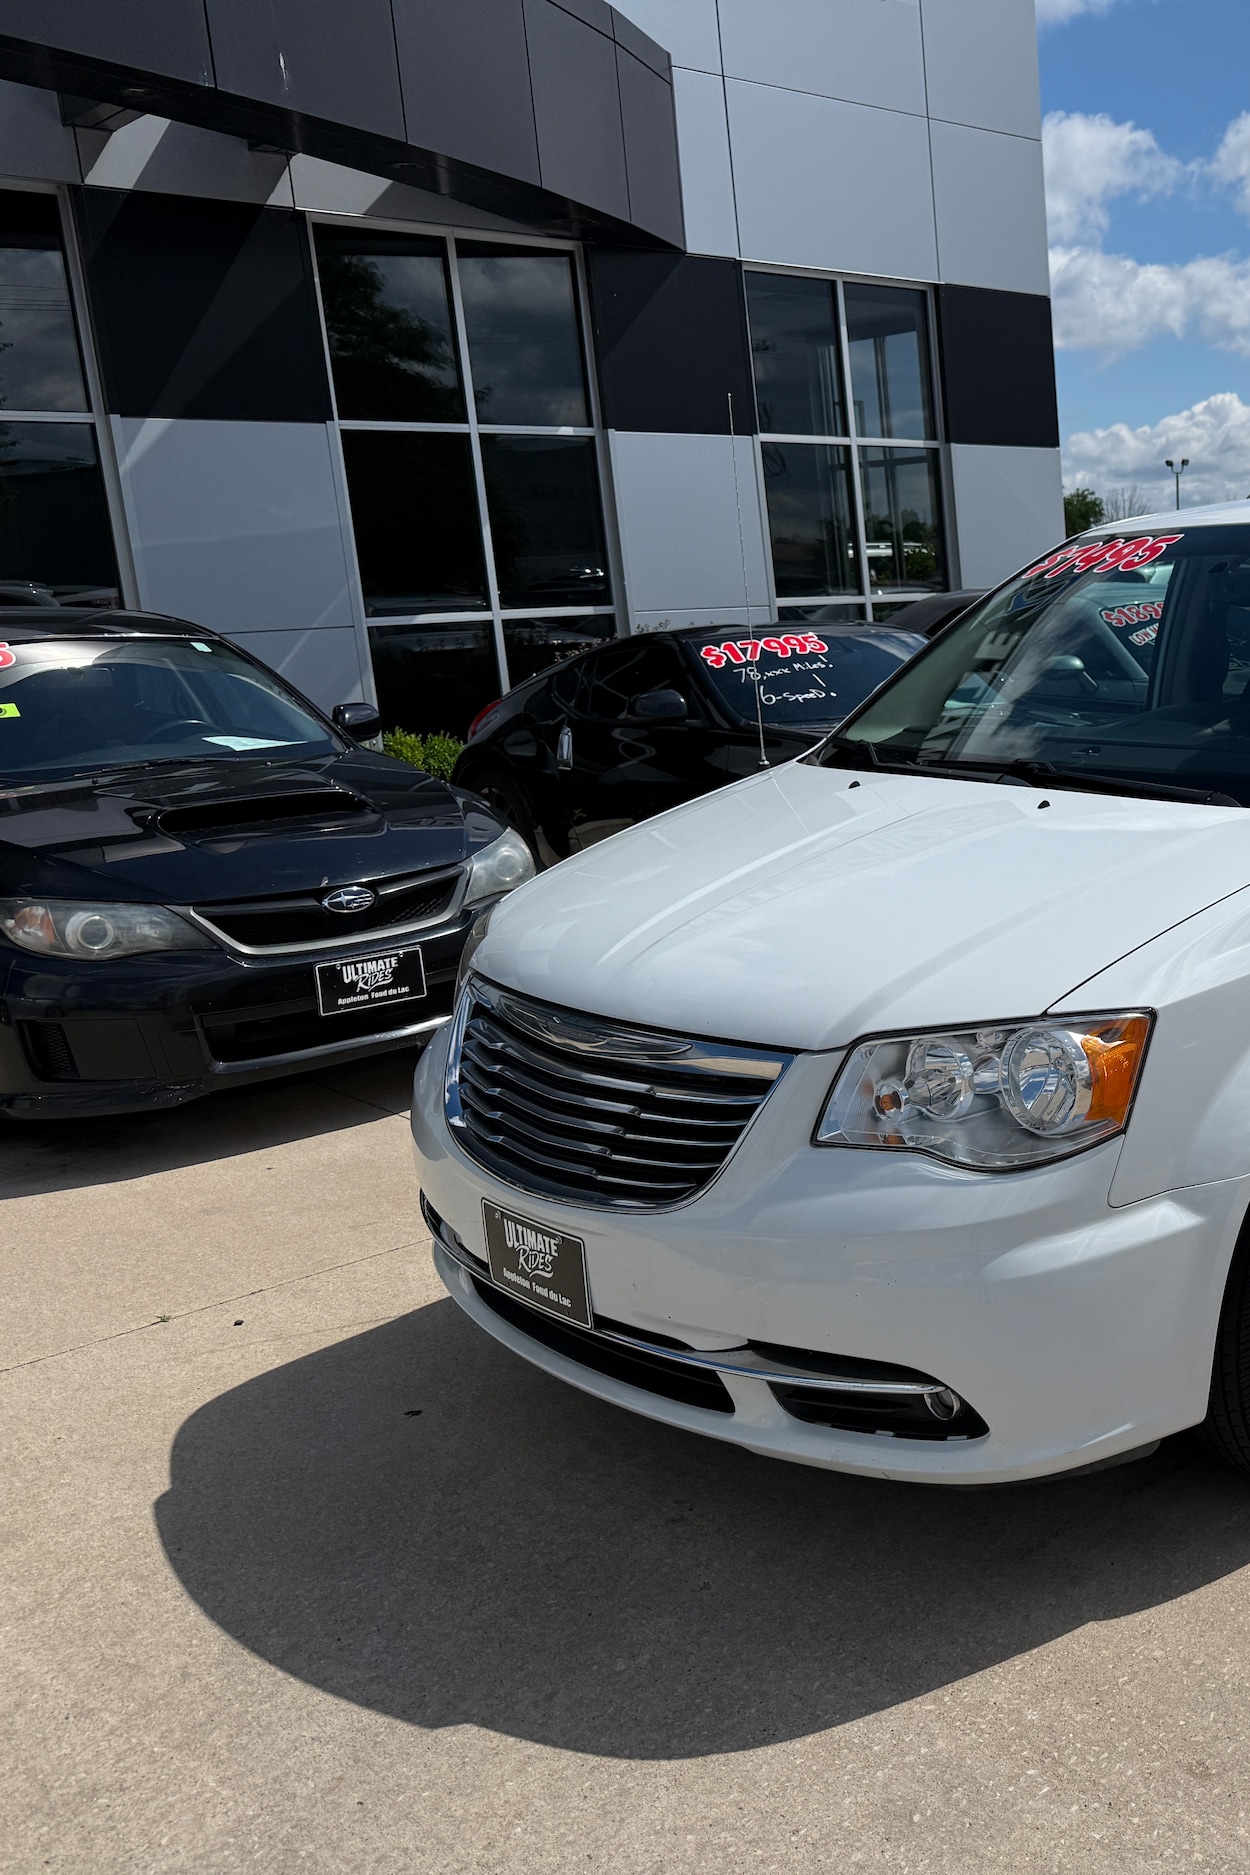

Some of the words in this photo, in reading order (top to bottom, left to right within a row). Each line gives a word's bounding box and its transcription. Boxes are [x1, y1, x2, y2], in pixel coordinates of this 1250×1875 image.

[1022, 534, 1185, 579] $7495
[701, 632, 828, 668] $17995
[342, 957, 399, 984] ULTIMATE
[337, 994, 369, 1006] Appleton
[371, 989, 388, 999] Fond
[388, 987, 398, 996] du
[397, 986, 410, 994] Lac
[503, 1218, 559, 1257] ULTIMATE
[503, 1267, 531, 1290] Appleton
[532, 1281, 549, 1298] Fond
[549, 1289, 558, 1303] du
[559, 1293, 572, 1308] Lac
